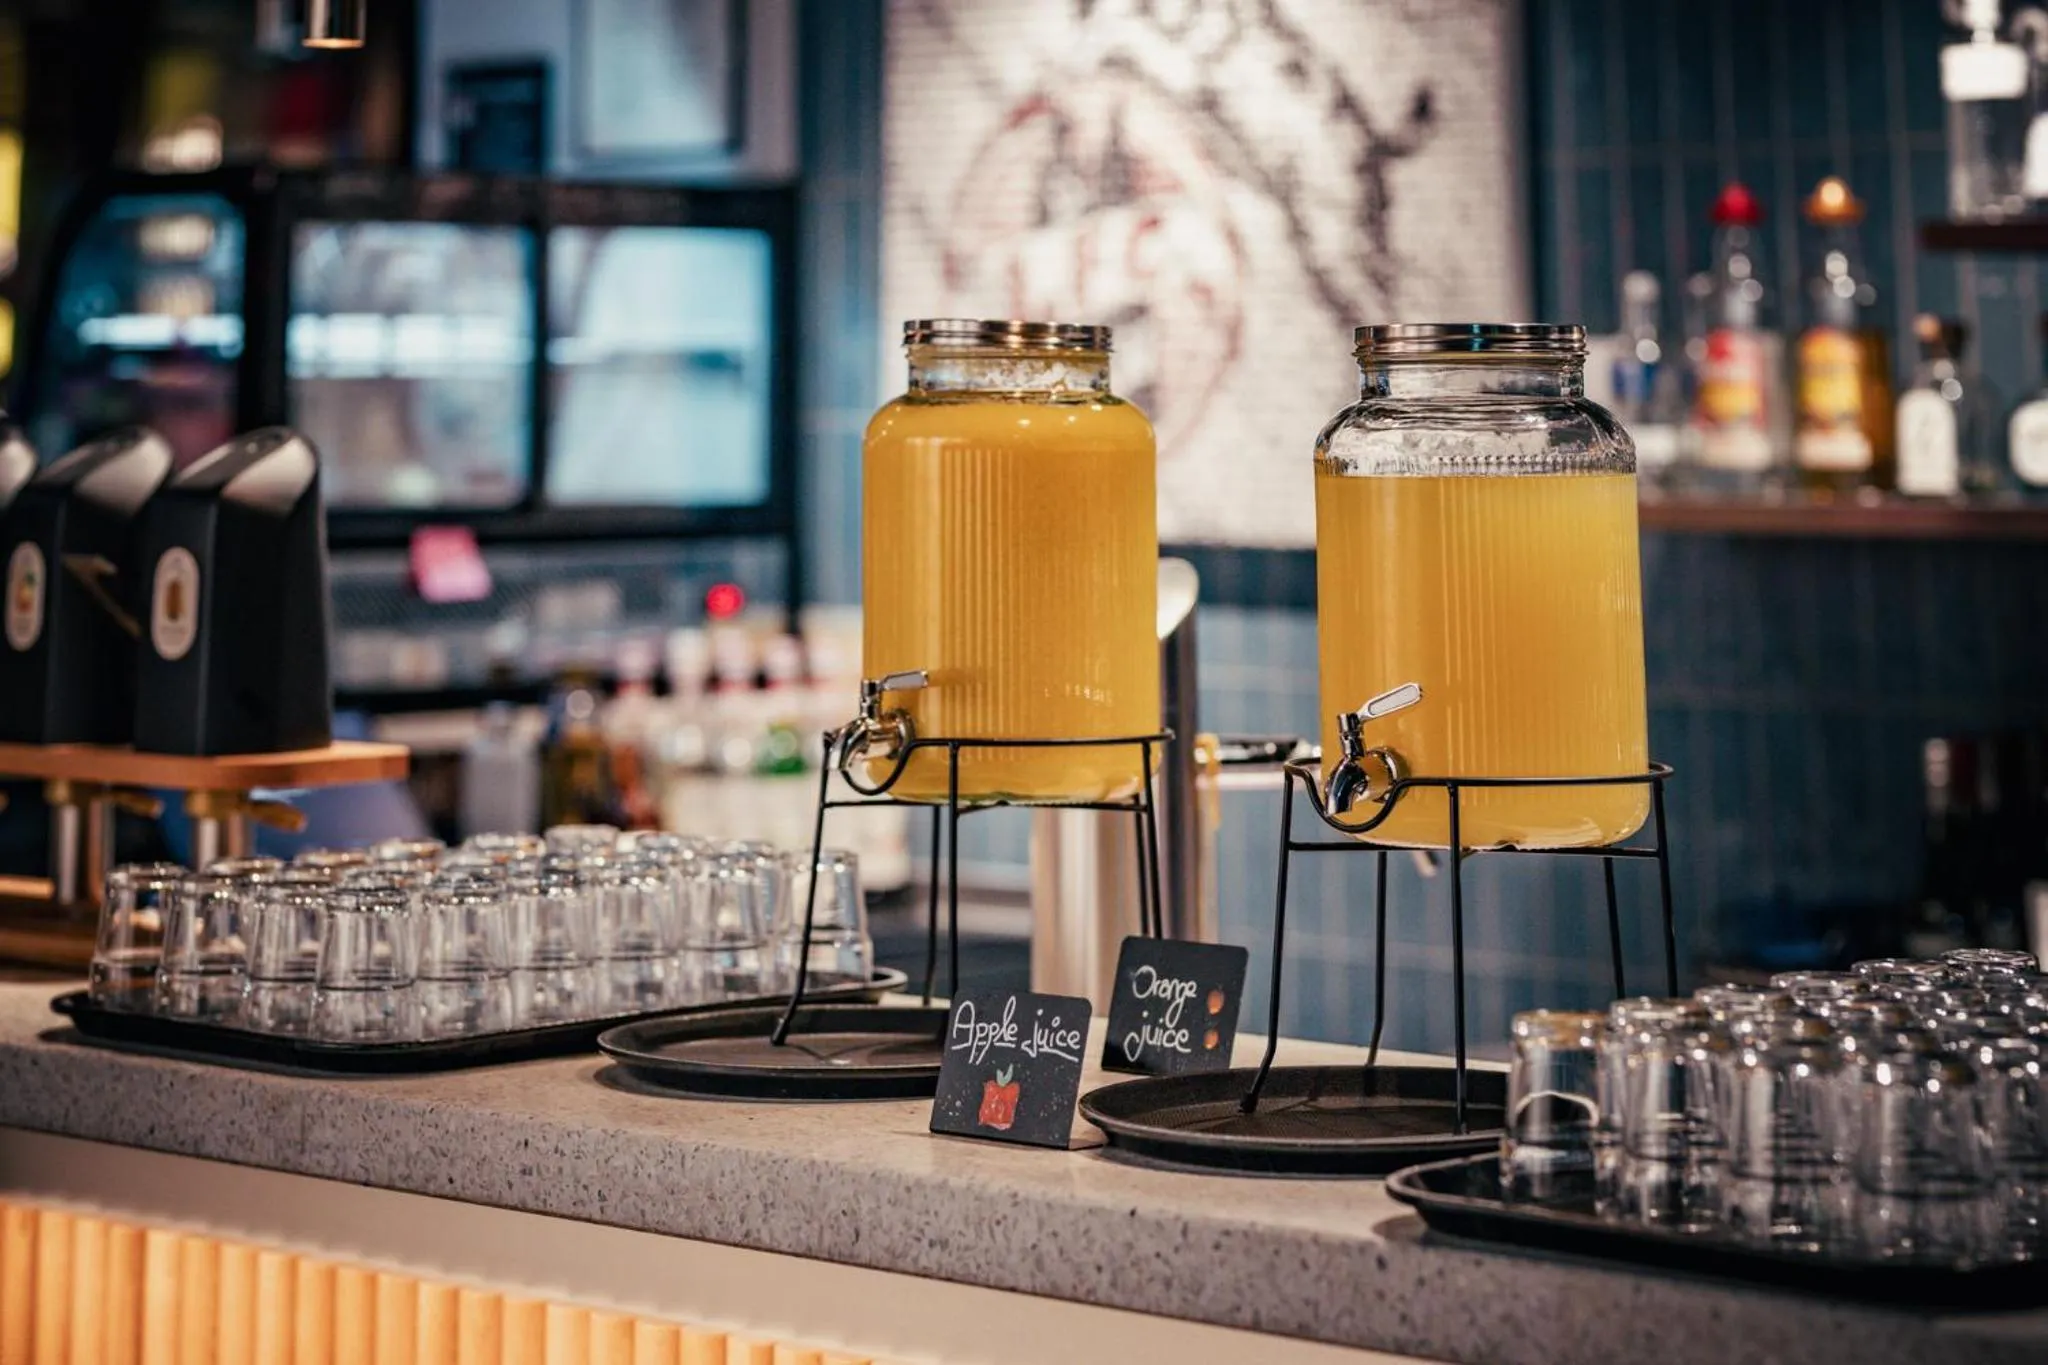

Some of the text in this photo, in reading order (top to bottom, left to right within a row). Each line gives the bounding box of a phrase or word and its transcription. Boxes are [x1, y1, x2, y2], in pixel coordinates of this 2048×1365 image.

[1132, 965, 1198, 1028] Orange
[952, 996, 1081, 1065] Apple juice
[1124, 1010, 1192, 1062] juice
